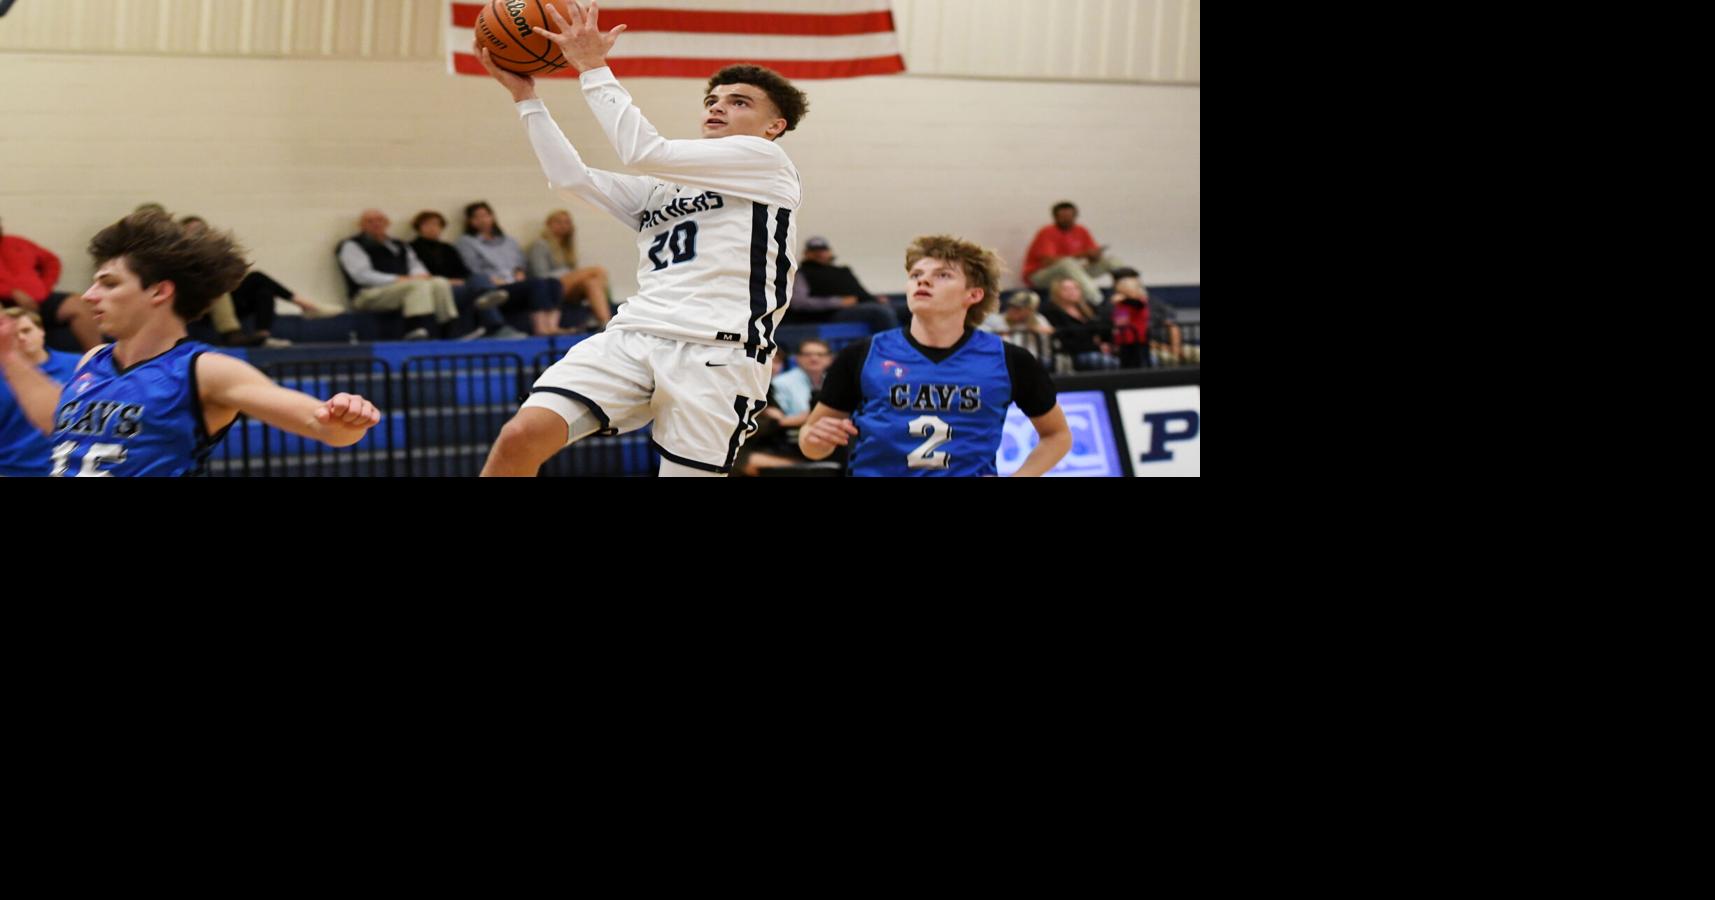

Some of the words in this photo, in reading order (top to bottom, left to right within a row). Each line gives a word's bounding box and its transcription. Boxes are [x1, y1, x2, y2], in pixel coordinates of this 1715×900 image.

[648, 220, 698, 272] 20
[55, 401, 144, 438] CAVS
[890, 384, 980, 412] CAVS
[907, 415, 952, 469] 2
